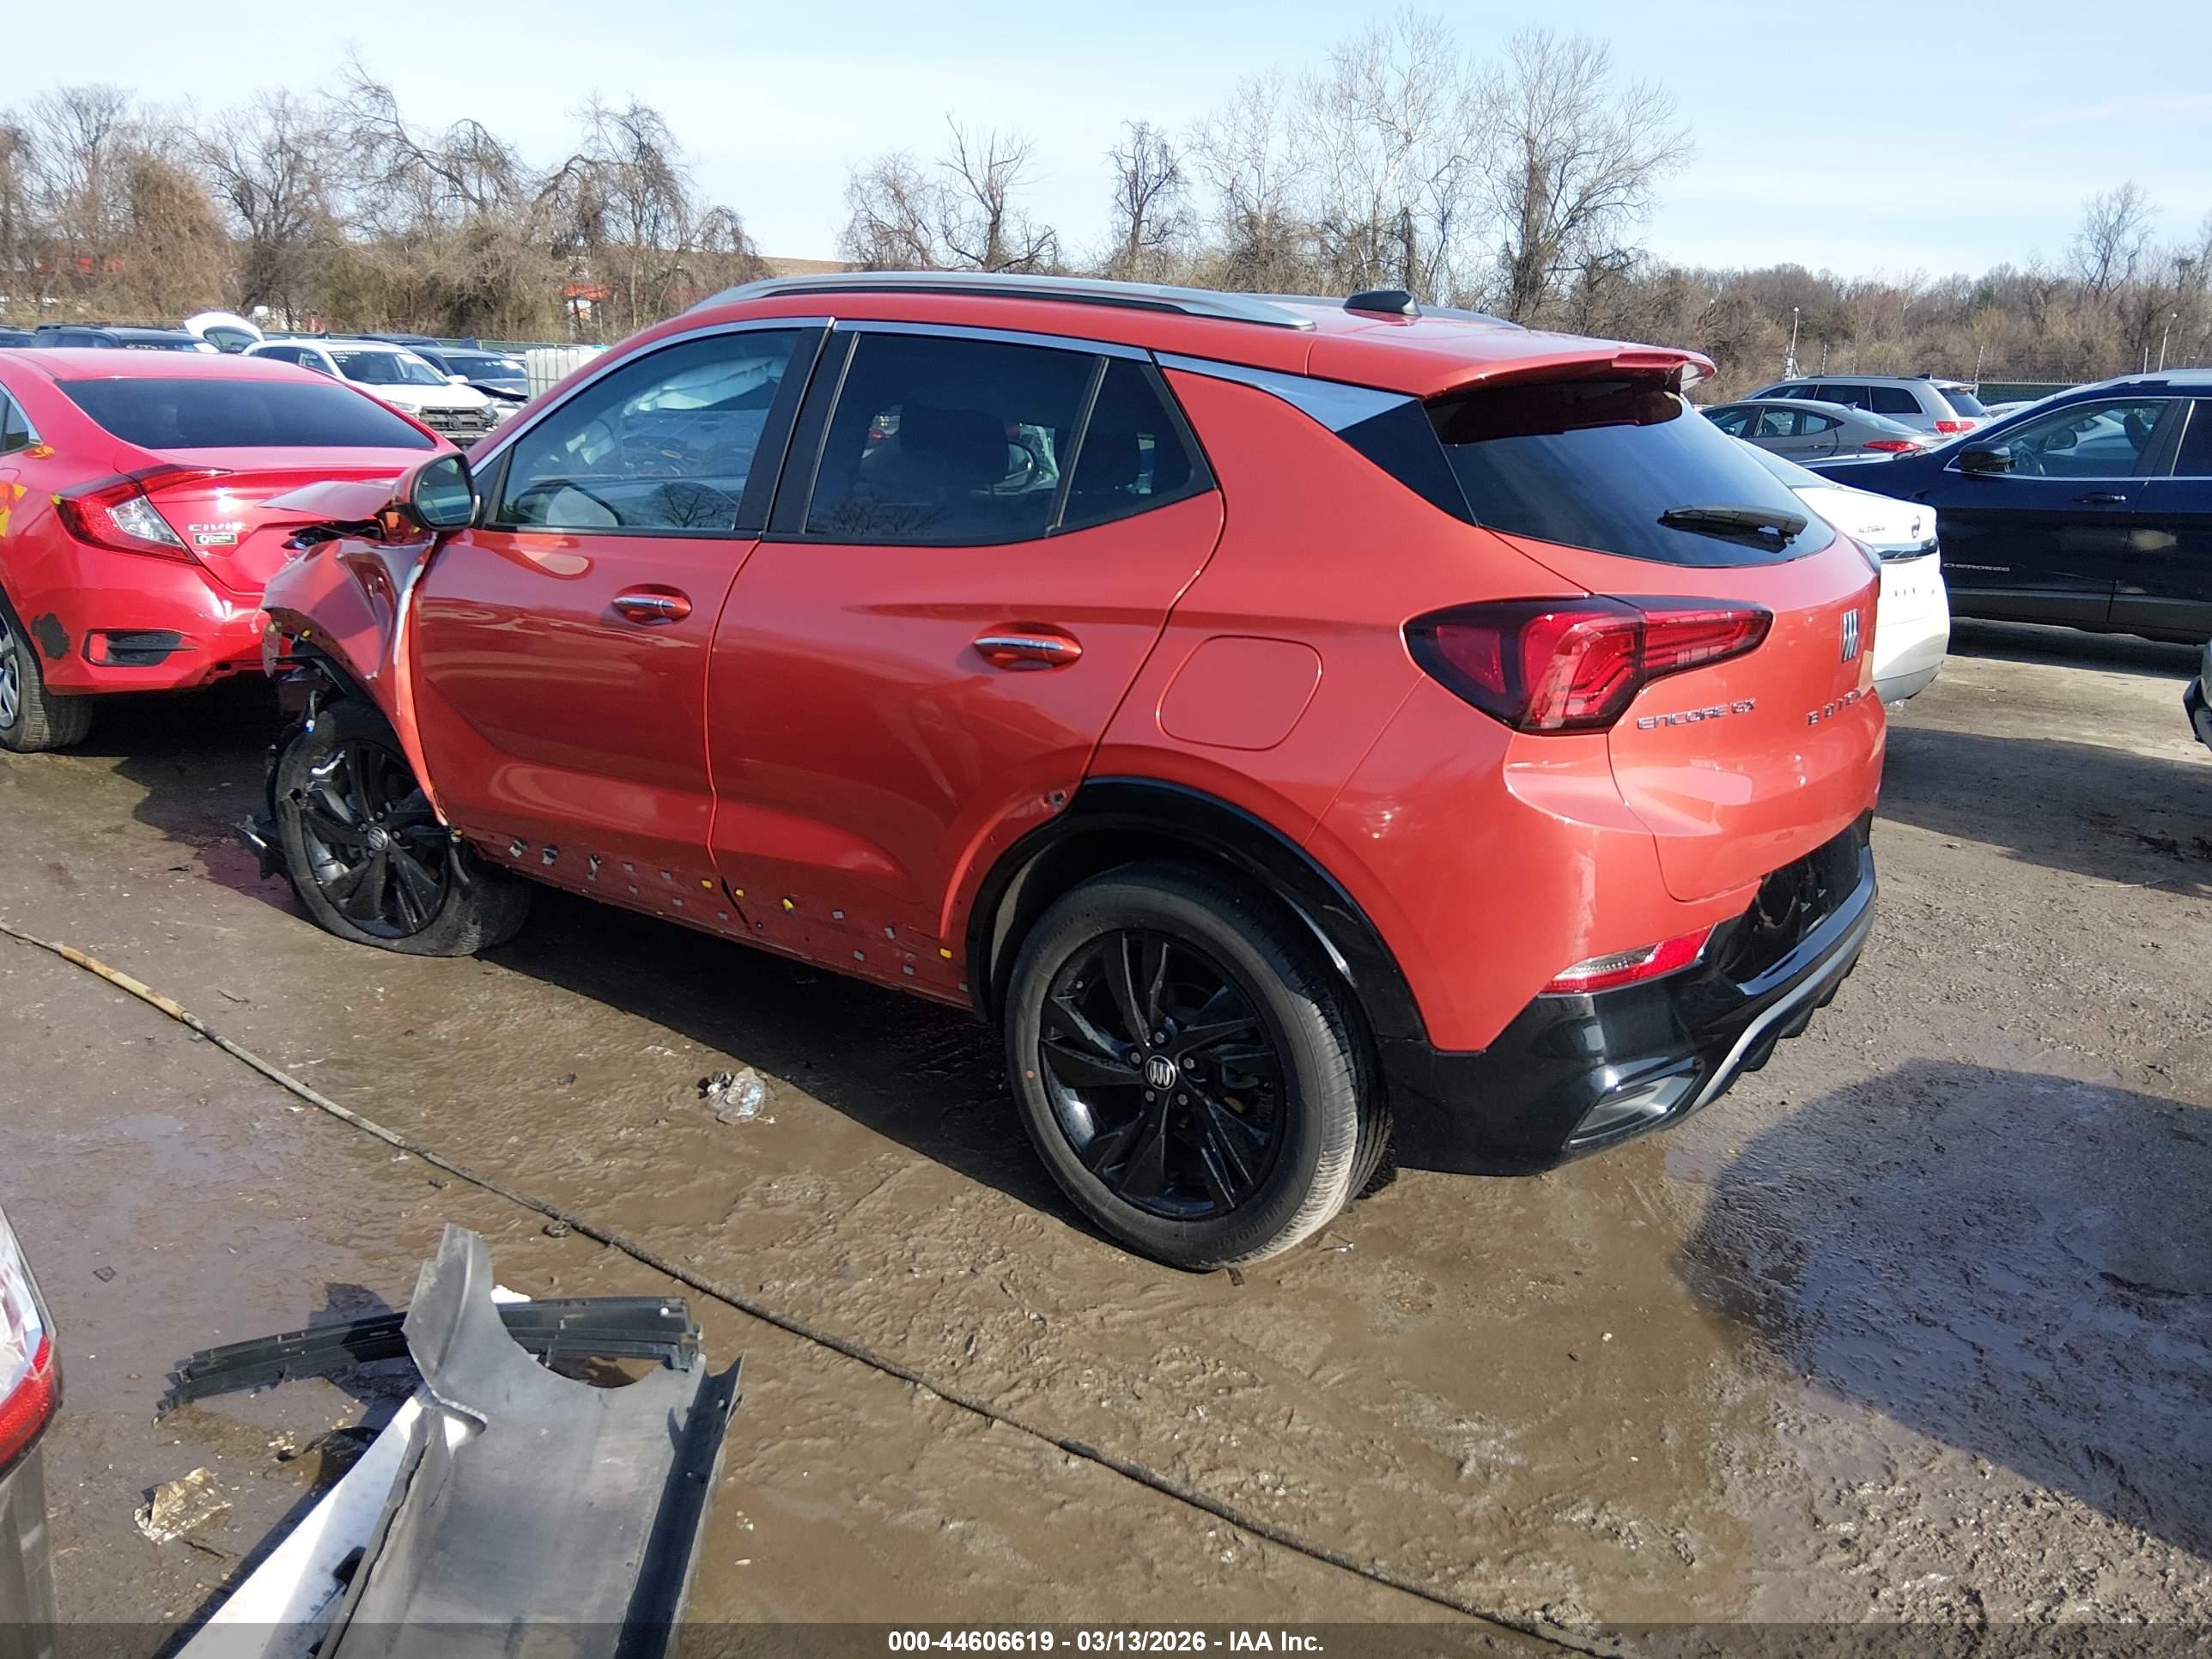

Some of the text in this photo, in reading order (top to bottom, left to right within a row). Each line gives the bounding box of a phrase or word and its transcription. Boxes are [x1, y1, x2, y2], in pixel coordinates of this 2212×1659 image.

[188, 521, 245, 532] CIVIC
[1942, 562, 2010, 573] CHEROKEE
[1637, 698, 1756, 730] ENCORE GX
